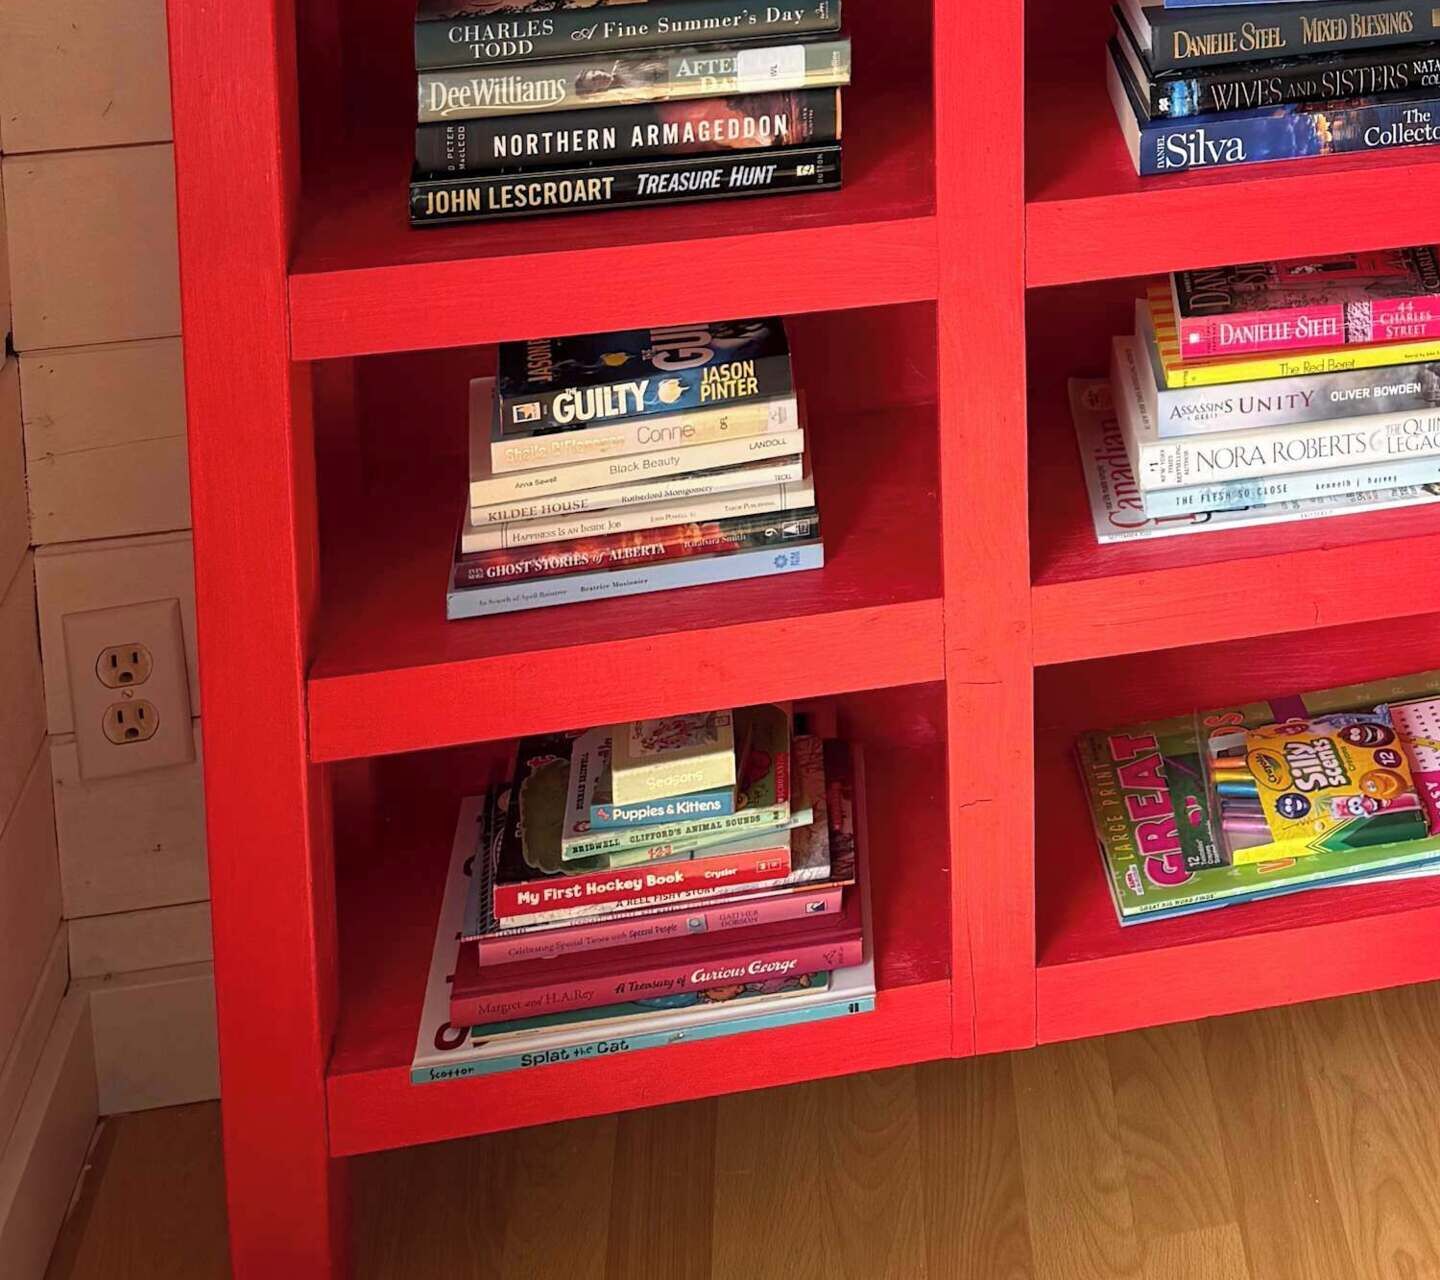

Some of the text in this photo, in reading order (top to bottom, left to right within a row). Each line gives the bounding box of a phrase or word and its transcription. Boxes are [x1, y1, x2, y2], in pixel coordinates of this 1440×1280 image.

[448, 18, 554, 44] CHARLES
[603, 19, 649, 39] Fine
[657, 10, 757, 34] Summer's
[766, 6, 805, 25] Day
[1173, 10, 1414, 60] DANIELLE STEEL MIXED BLESSINGS
[469, 40, 534, 59] TODD
[675, 57, 738, 77] AFTE
[1210, 62, 1409, 112] WIVES AND SISTERS
[1402, 109, 1431, 125] The
[493, 126, 617, 158] NORTHERN
[631, 113, 789, 148] ARMAGEDDON
[1165, 129, 1247, 169] Silva
[1156, 134, 1166, 169] DANIEL
[636, 169, 724, 196] TREASURE
[729, 164, 778, 188] HUNT
[425, 177, 615, 215] JOHN LESCROART
[1219, 320, 1292, 346] DANIELLE
[1294, 316, 1337, 338] STEEL
[1386, 323, 1428, 337] STREET
[701, 359, 755, 385] JASON
[1279, 362, 1301, 375] The
[1303, 359, 1326, 373] Red
[552, 379, 650, 424] GUILTY
[700, 377, 759, 402] PINTER
[1239, 390, 1315, 414] UNITY
[1330, 382, 1422, 403] OLIVER BOWDEN
[609, 455, 681, 475] Black Beauty
[1197, 432, 1367, 473] NORA ROBERTS
[514, 479, 533, 489] Anna
[1175, 495, 1193, 506] THE
[1256, 484, 1288, 497] CLOSE
[487, 498, 590, 522] KILDEE HOUSE
[486, 543, 666, 579] GHOST STORIES of ALBERTA
[1286, 742, 1329, 792] Silly
[1379, 751, 1396, 765] 12
[646, 770, 704, 791] Seasons
[611, 798, 722, 822] Puppies & Kittens
[1097, 763, 1136, 862] LARGE PRINT
[1108, 734, 1196, 888] GREAT
[571, 838, 621, 854] BRIDWELL
[685, 821, 723, 835] ANIMAL
[726, 814, 762, 828] SOUNDS
[1187, 855, 1200, 867] 12
[517, 870, 685, 906] My First Hockey Book
[615, 958, 798, 994] A Treasury of Curious George
[477, 996, 543, 1017] Margret and
[521, 1048, 570, 1068] Splat
[573, 1046, 594, 1057] the
[597, 1040, 630, 1054] Cat
